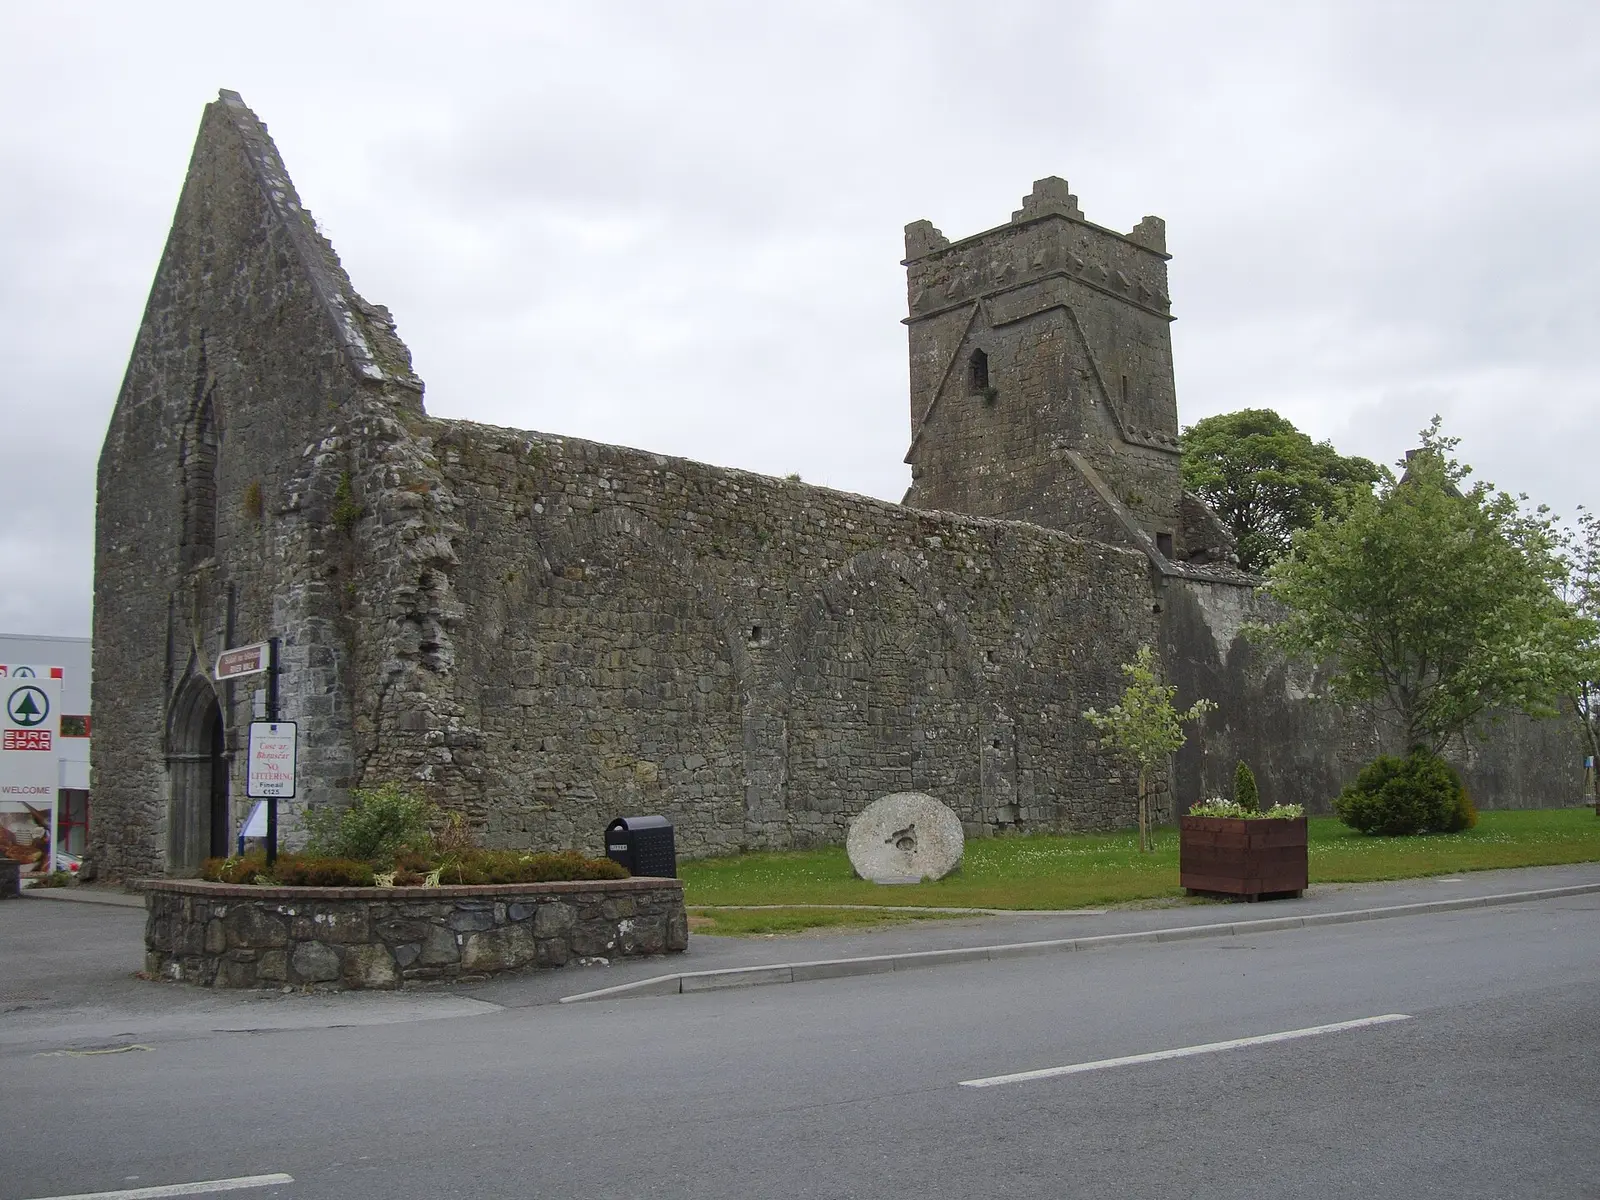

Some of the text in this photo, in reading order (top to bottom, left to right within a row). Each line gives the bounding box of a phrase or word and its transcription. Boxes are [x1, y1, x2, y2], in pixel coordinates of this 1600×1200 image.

[4, 731, 51, 740] EURO
[4, 740, 51, 749] SPAR
[267, 763, 279, 771] NO
[251, 772, 293, 780] LITTERING
[2, 786, 51, 794] WELCOME
